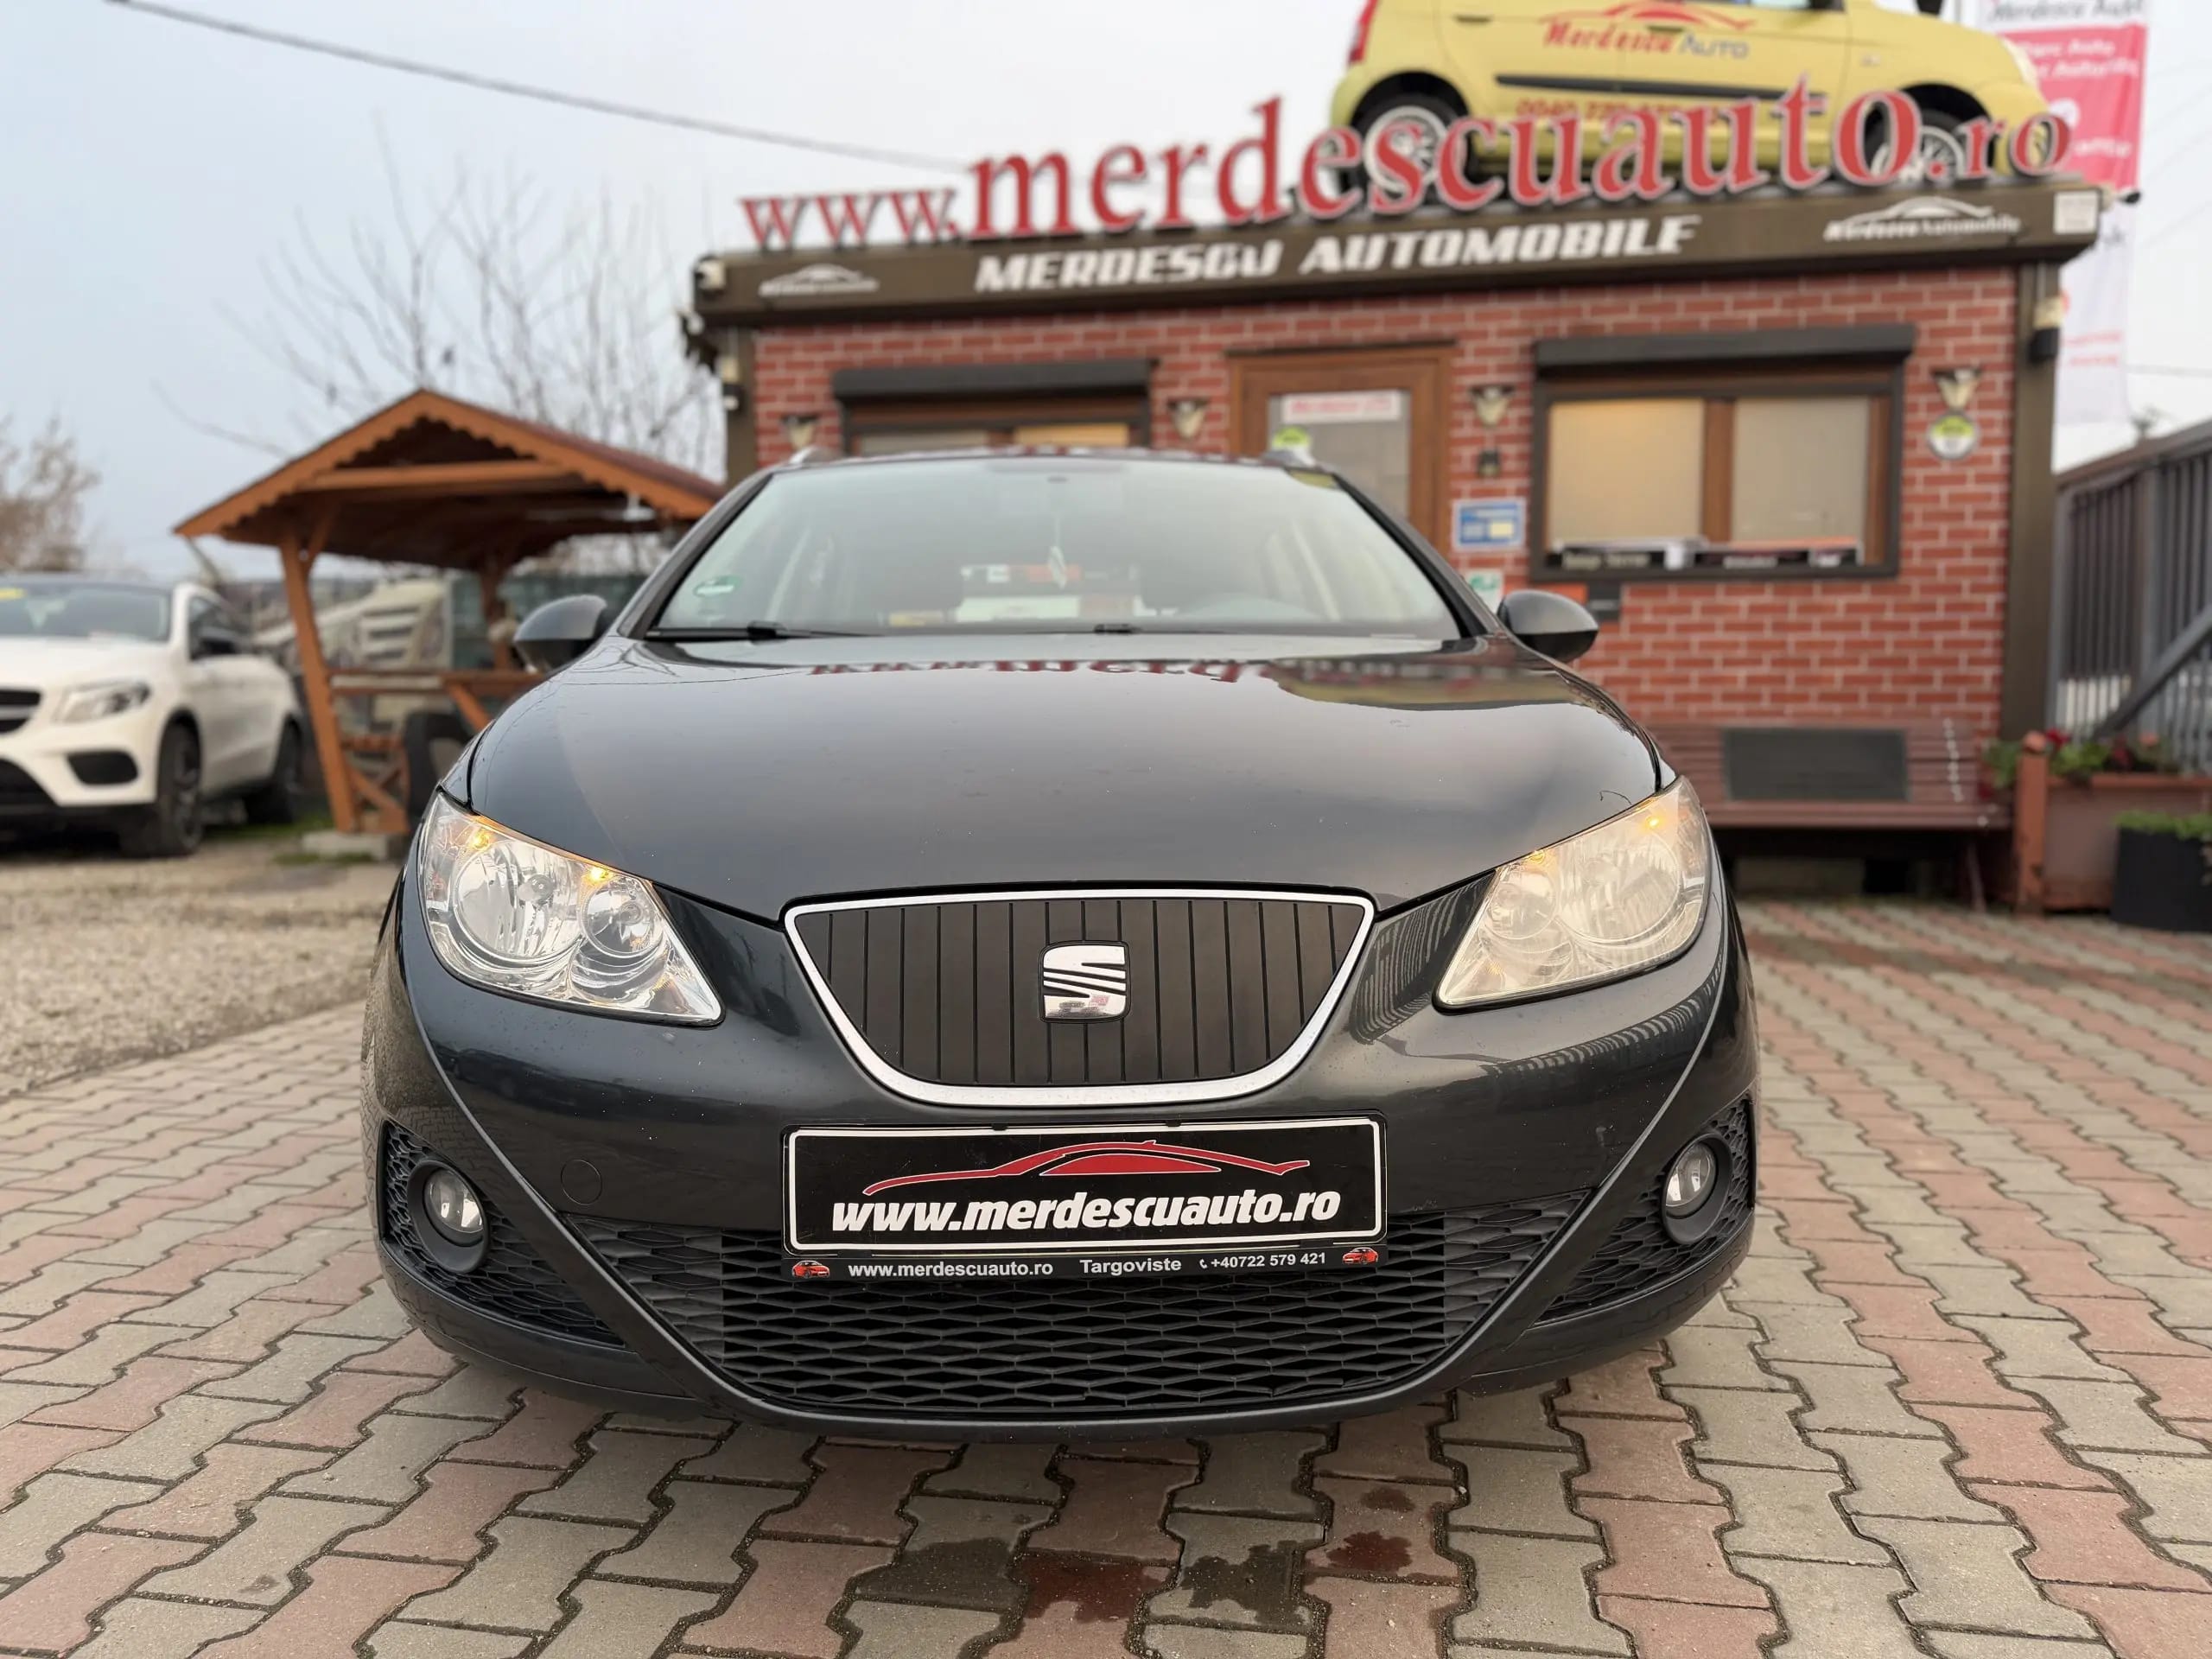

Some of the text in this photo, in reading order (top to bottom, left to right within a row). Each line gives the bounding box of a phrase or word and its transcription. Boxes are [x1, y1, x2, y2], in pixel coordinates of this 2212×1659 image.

[738, 73, 2074, 246] www.merdescuauto.ro
[975, 216, 1700, 292] MERDESCU AUTOMOBILE
[832, 1190, 1340, 1232] www.merdescuauto.ro
[848, 1252, 1326, 1278] www.merdescuauto.ro Targoviste +40722 579 421
